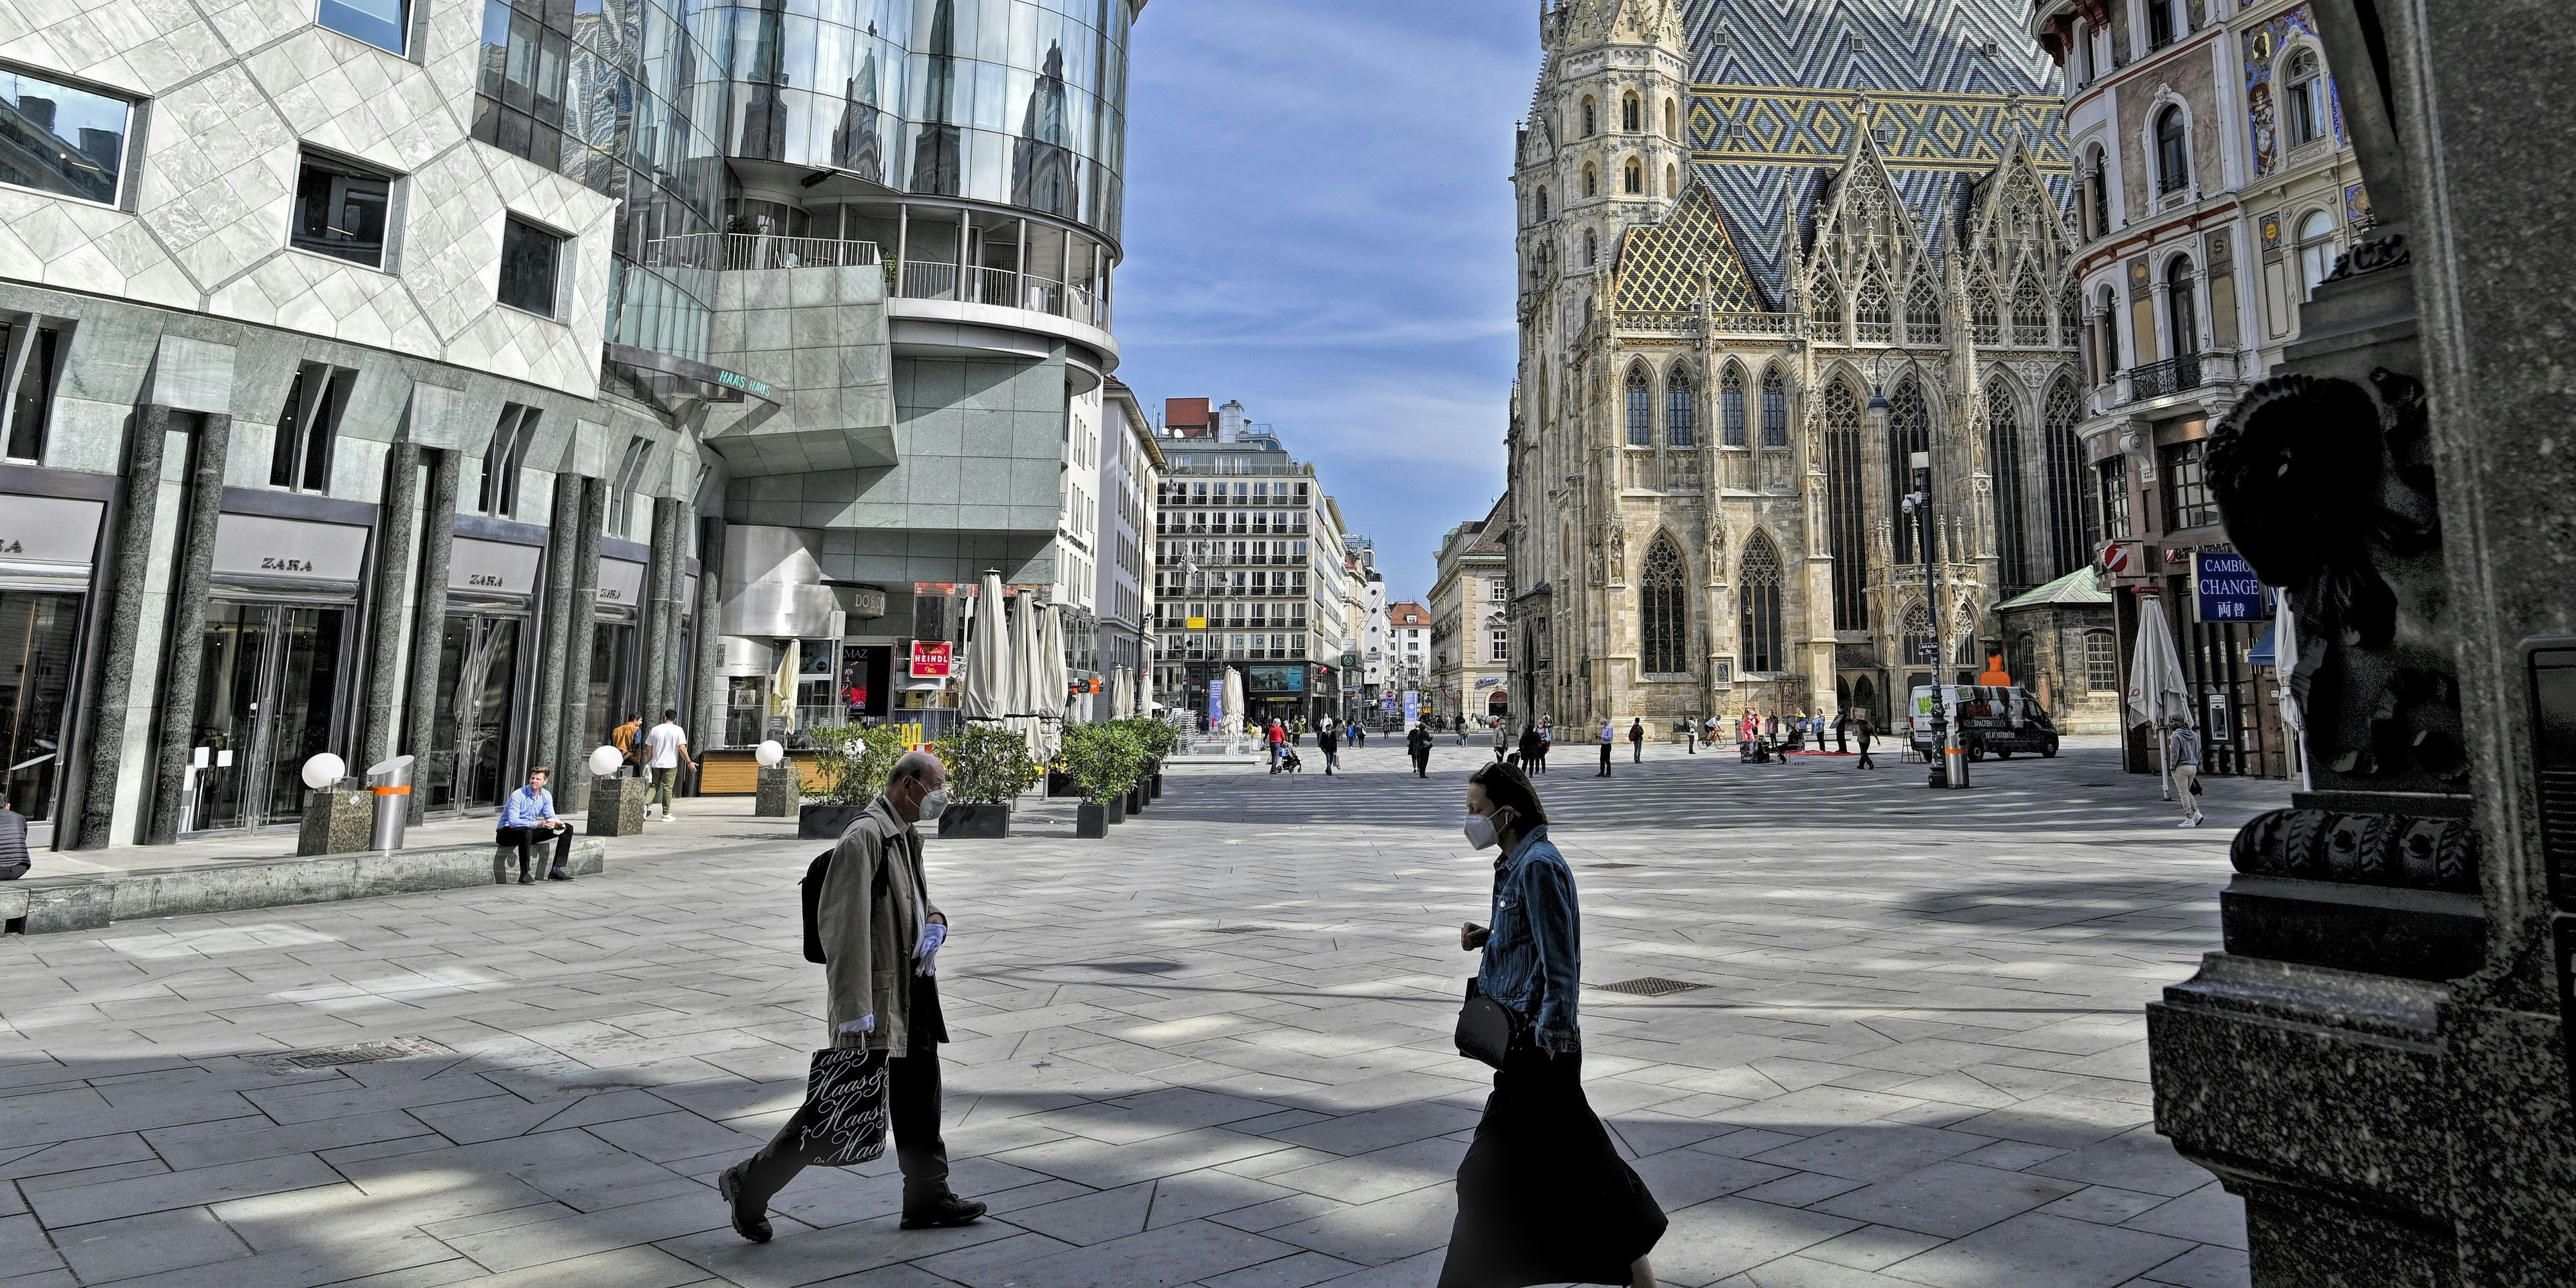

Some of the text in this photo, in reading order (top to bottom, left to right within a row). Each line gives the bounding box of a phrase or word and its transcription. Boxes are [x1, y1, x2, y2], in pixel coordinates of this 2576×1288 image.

[719, 370, 771, 397] HAAS HAUS
[261, 556, 313, 572] ZARA
[469, 574, 504, 587] ZARA
[2200, 579, 2259, 596] CHANGE
[600, 588, 621, 600] ZARA
[2217, 601, 2246, 618] 両替
[915, 654, 948, 663] HEINDL
